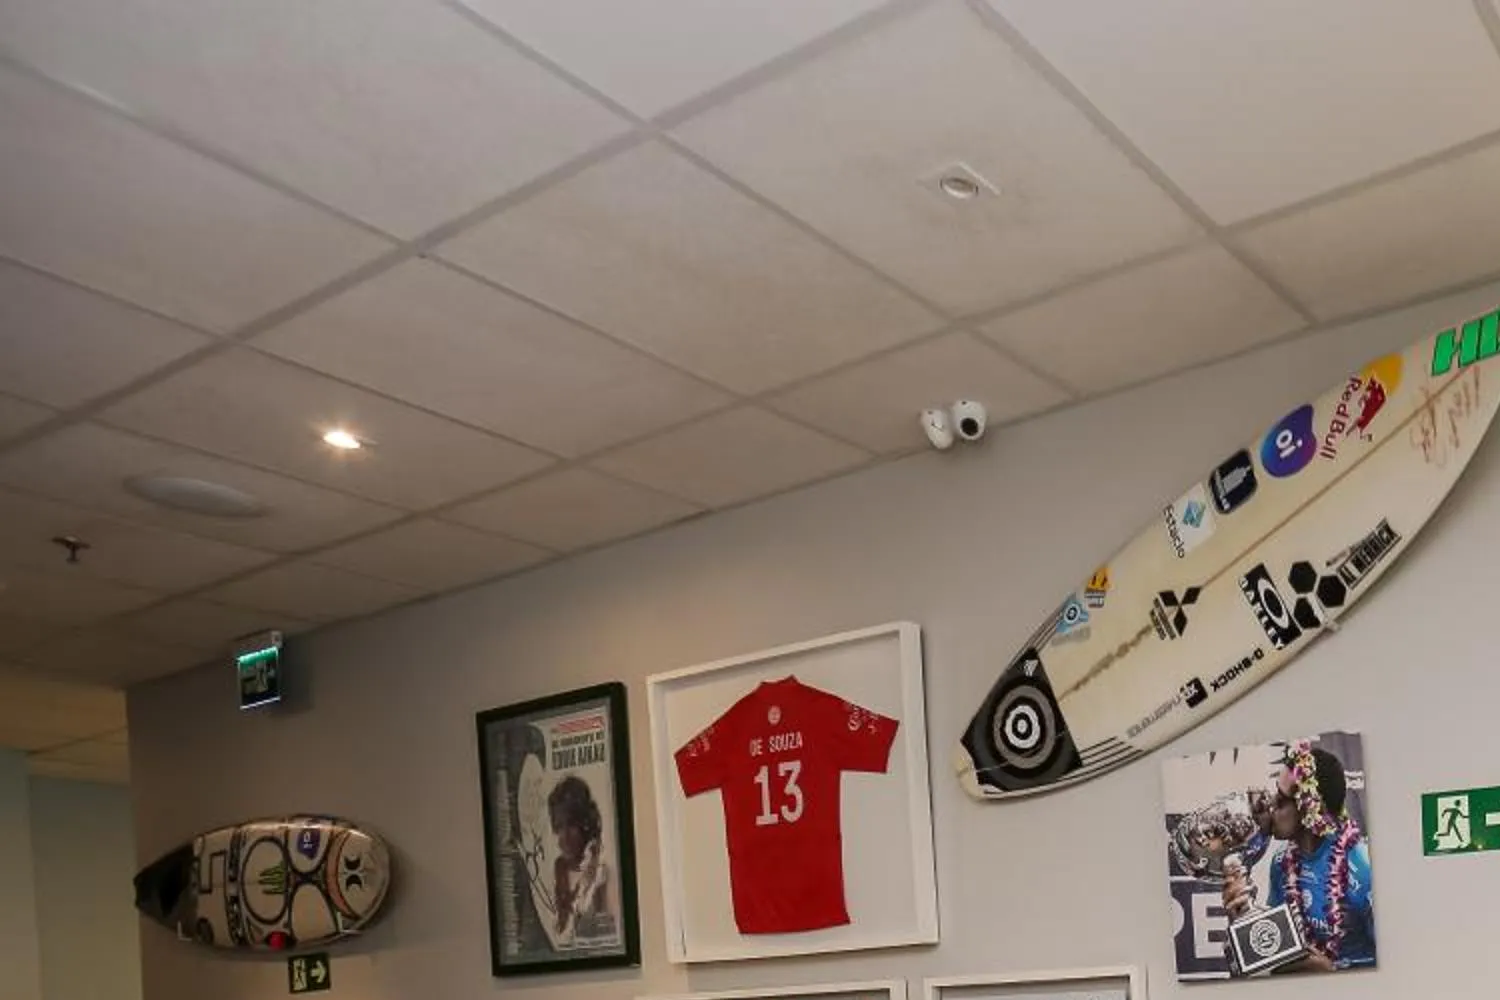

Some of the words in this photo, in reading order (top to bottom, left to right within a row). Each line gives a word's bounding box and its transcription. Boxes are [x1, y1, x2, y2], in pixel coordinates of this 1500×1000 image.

[1276, 429, 1303, 458] oi
[750, 739, 764, 757] DE
[769, 731, 803, 753] SOUZA
[754, 759, 804, 826] 13
